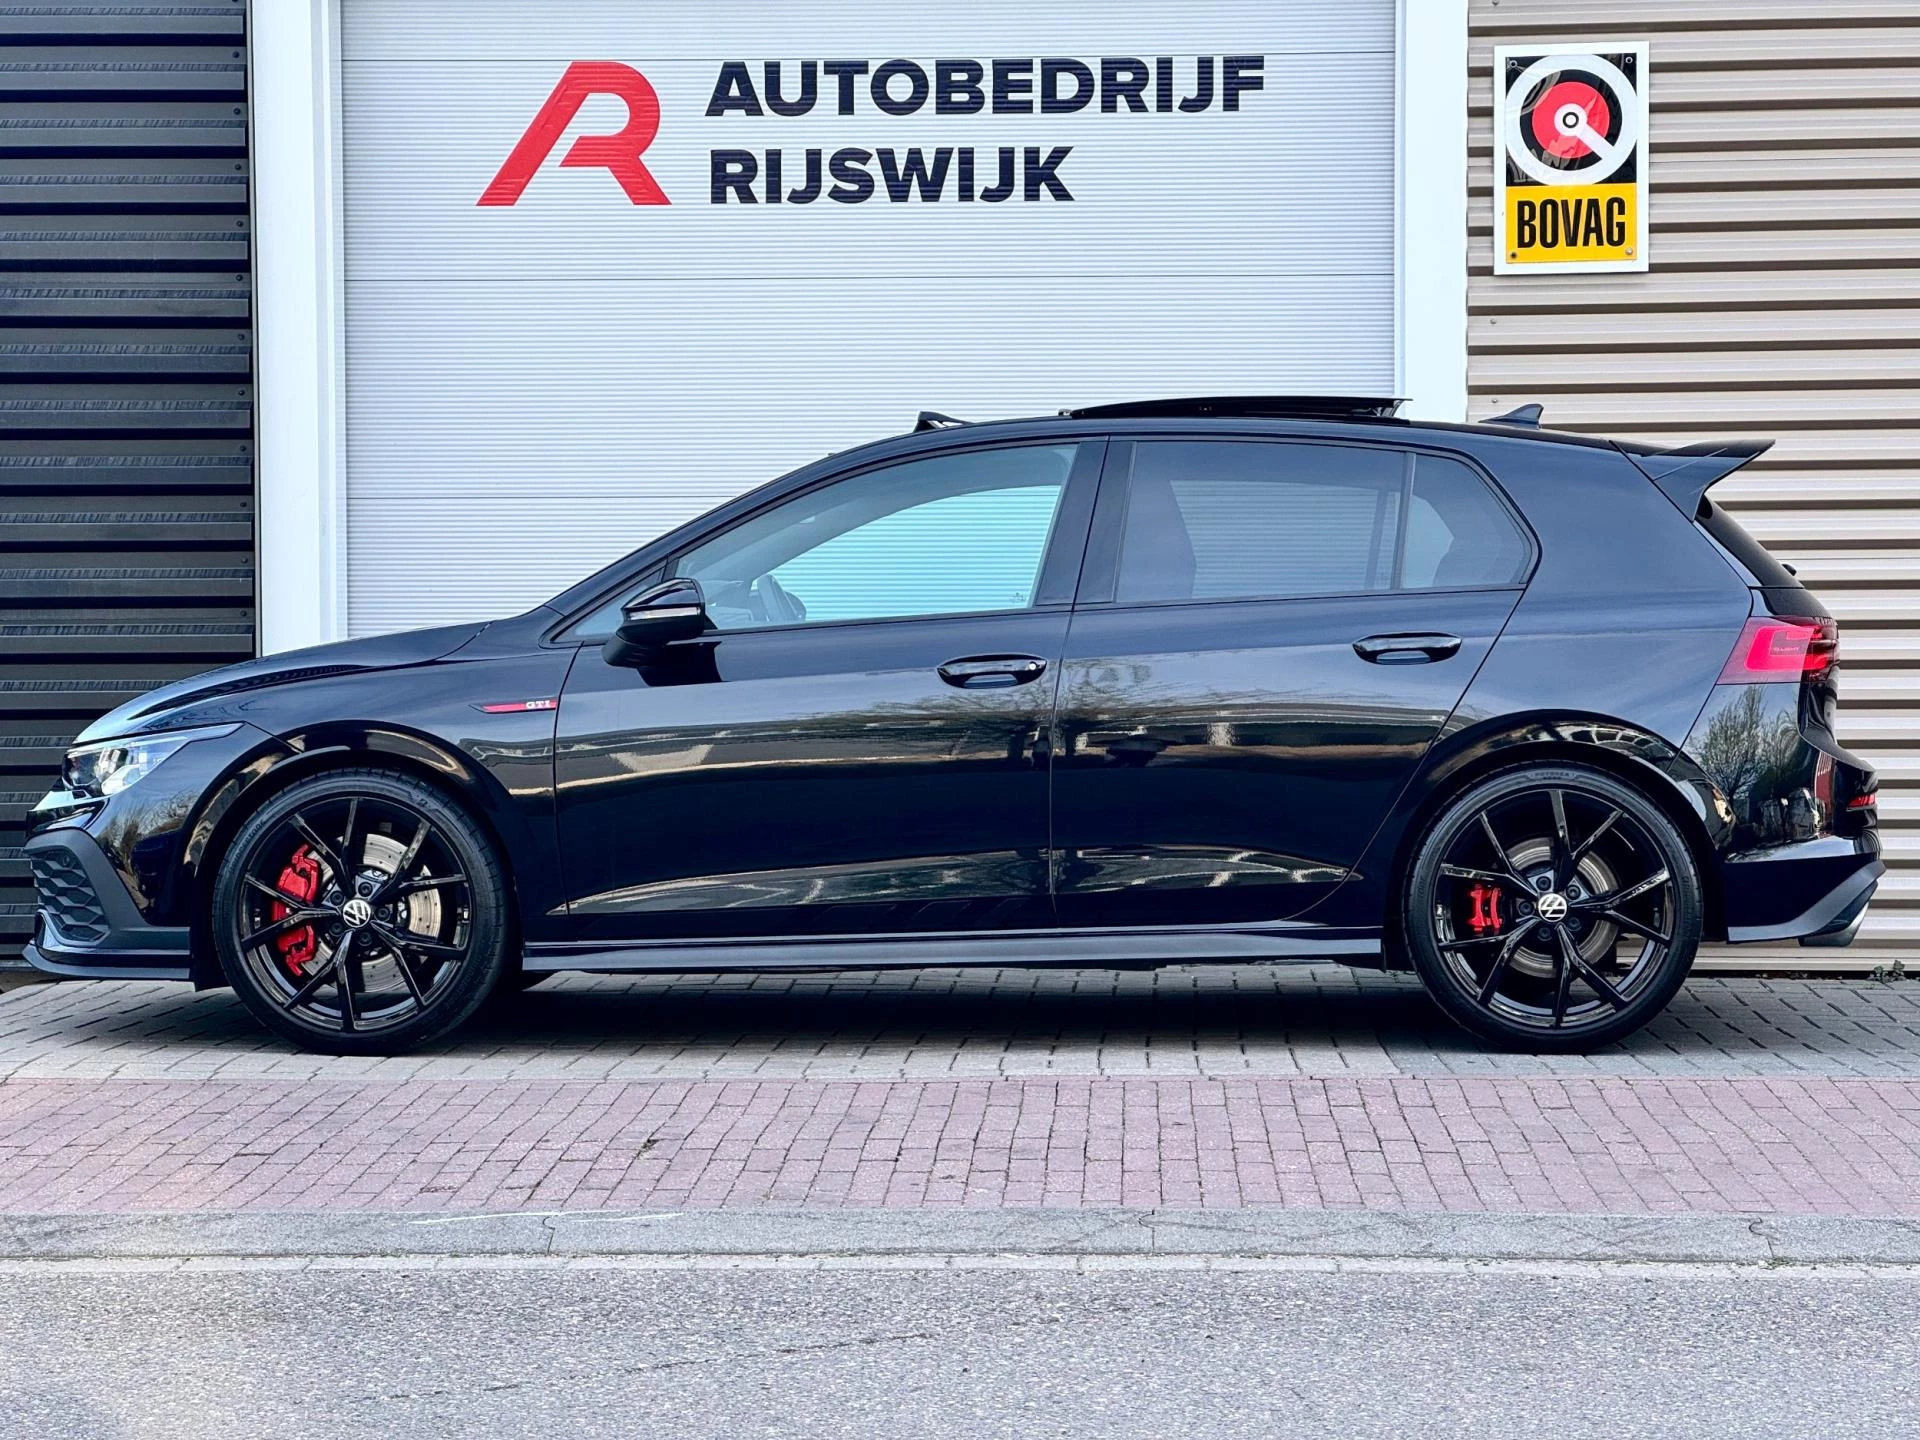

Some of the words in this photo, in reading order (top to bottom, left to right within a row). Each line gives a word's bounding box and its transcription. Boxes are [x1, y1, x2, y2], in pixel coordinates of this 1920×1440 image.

[705, 55, 1265, 117] AUTOBEDRIJF
[711, 146, 1075, 205] RIJSWIJK
[1517, 197, 1626, 249] BOVAG
[526, 700, 550, 709] GTI
